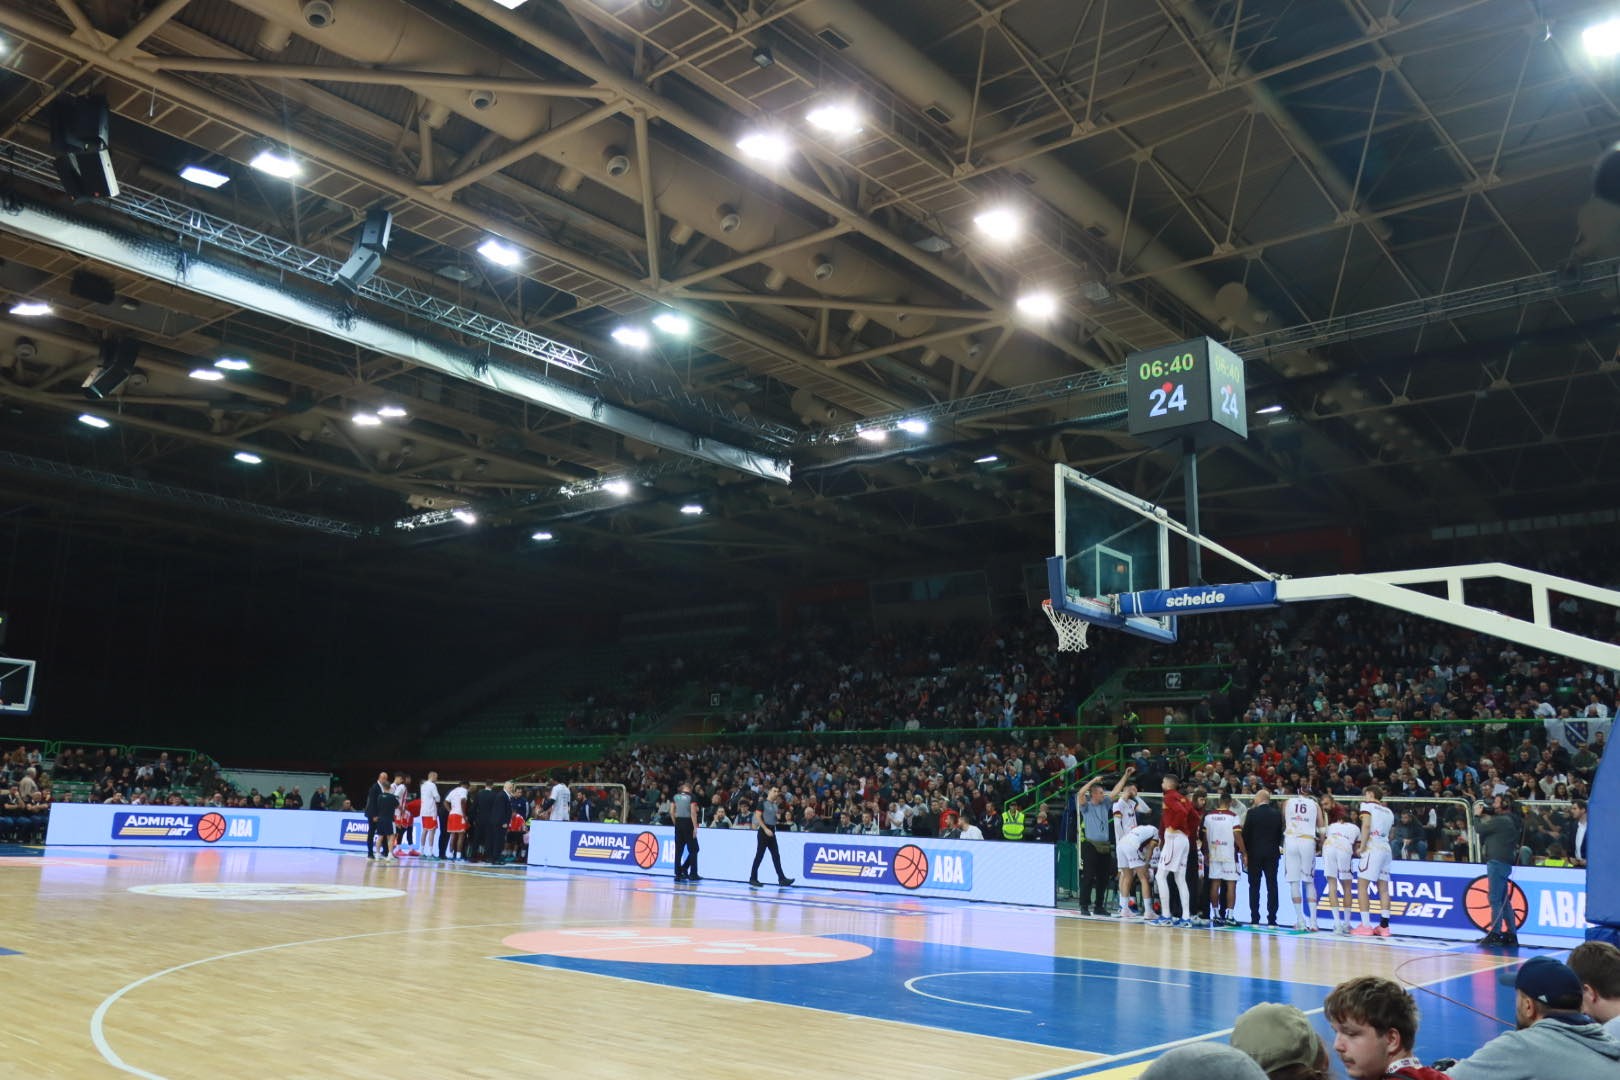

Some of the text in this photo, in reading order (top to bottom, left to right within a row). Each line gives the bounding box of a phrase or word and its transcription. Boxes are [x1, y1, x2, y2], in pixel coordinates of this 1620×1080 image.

[1140, 353, 1194, 380] 06:40
[1149, 384, 1187, 417] 24
[1220, 386, 1239, 418] 24
[1165, 590, 1226, 608] schelde
[1294, 803, 1307, 814] 16
[124, 815, 193, 828] ADMIRAL
[228, 818, 253, 838] ABA
[346, 821, 369, 833] ADMI
[167, 827, 193, 836] BET
[578, 833, 630, 849] ADMIRAL
[610, 849, 629, 860] BET
[661, 839, 675, 863] AB
[815, 847, 888, 866] ADMIRAL
[861, 865, 888, 878] BET
[933, 855, 964, 884] ABA
[1406, 903, 1453, 919] BET
